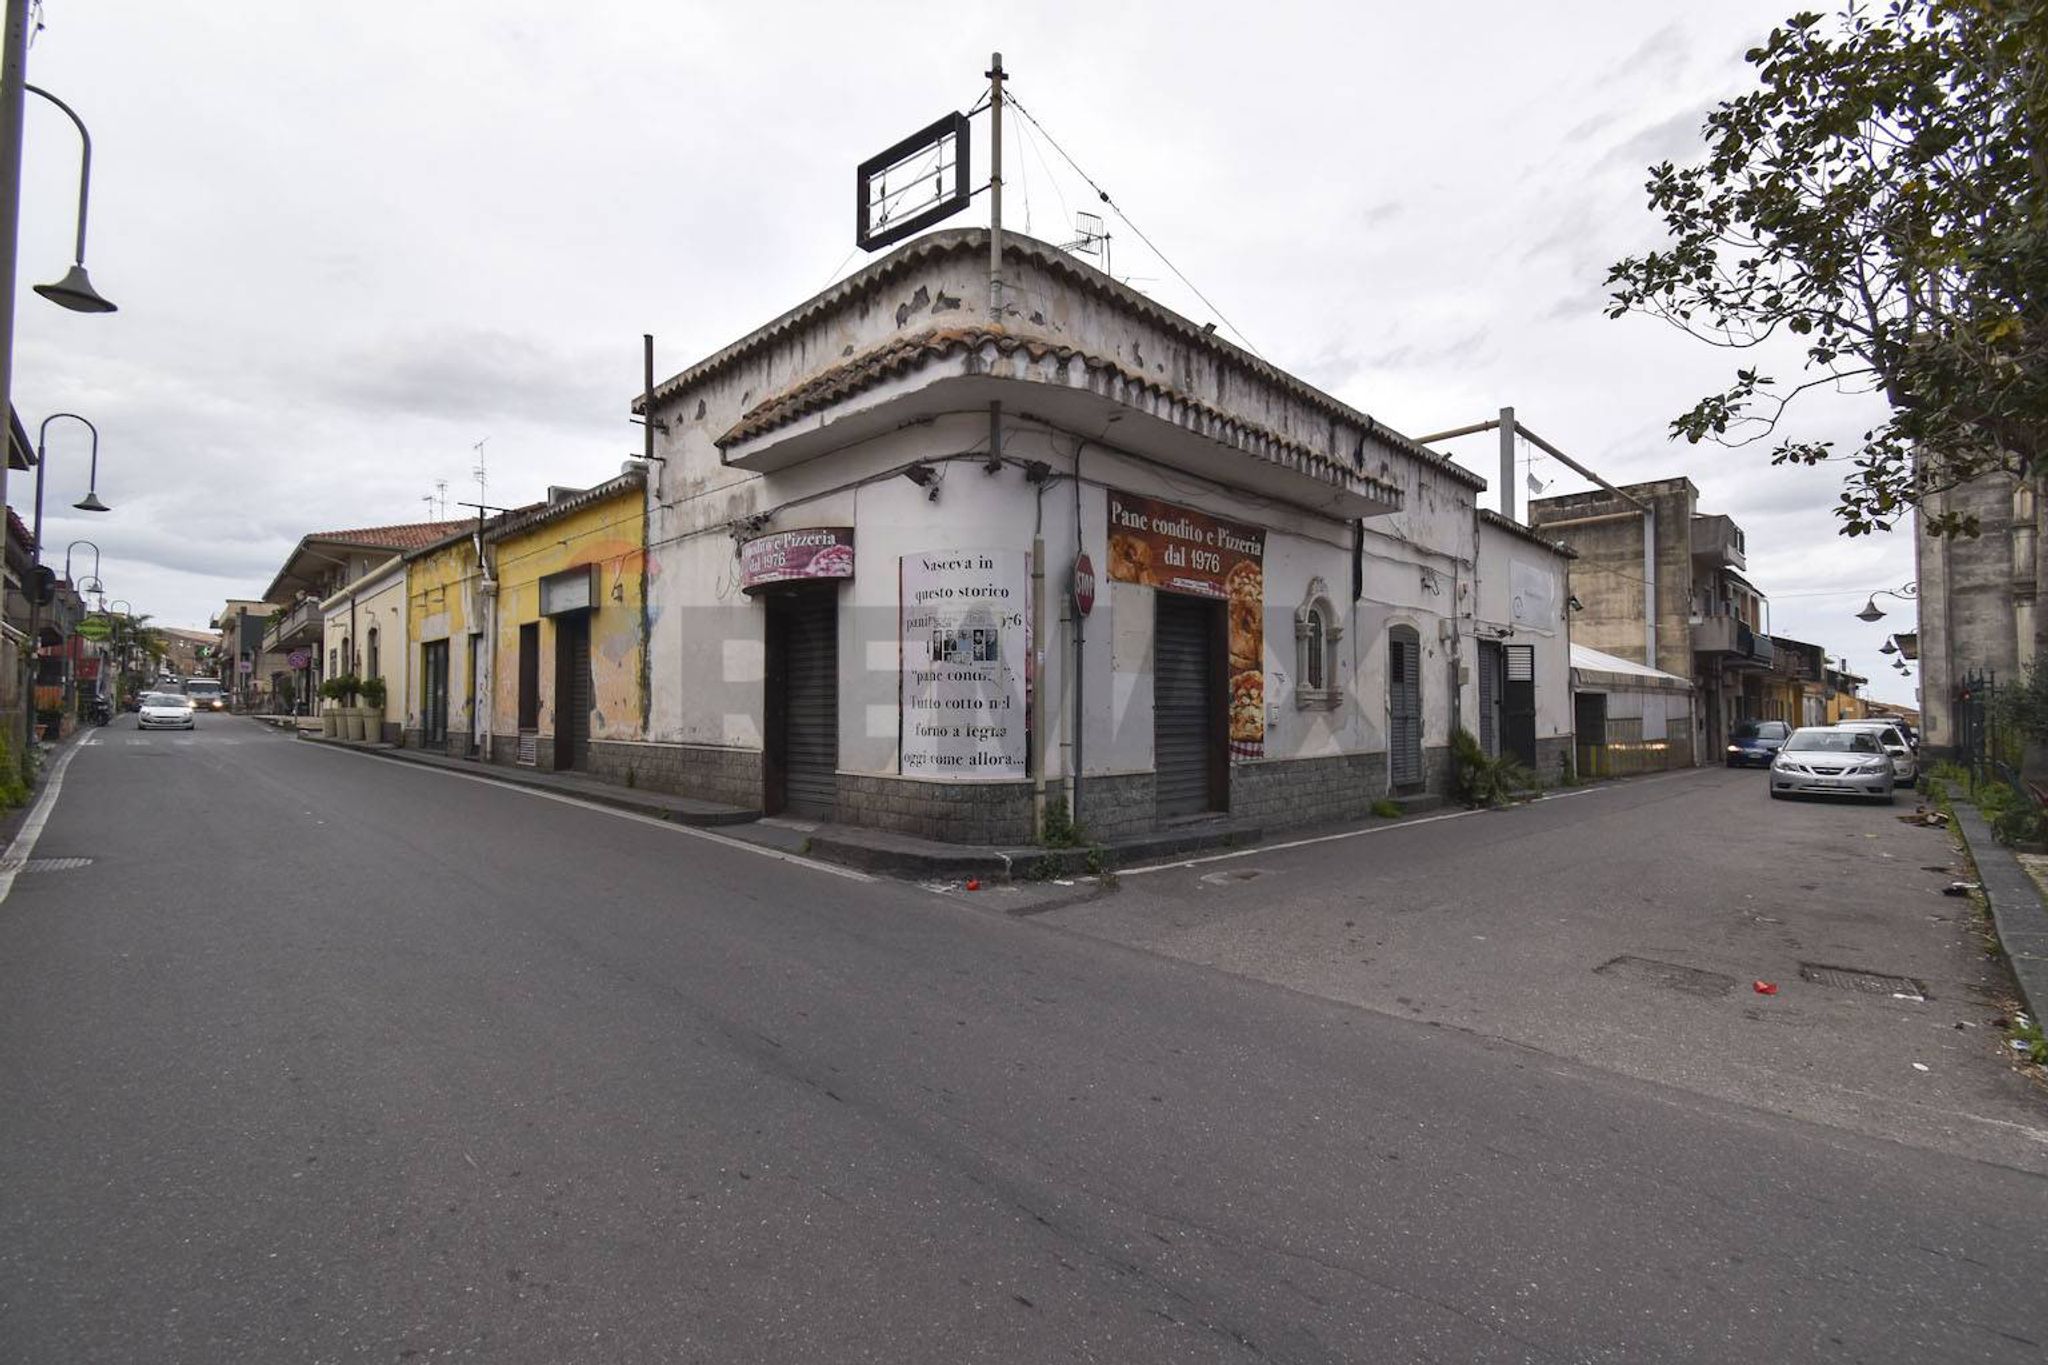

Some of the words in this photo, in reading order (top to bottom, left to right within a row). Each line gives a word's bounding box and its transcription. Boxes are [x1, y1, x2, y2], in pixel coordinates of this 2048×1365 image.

[1111, 501, 1149, 531] Pane
[1152, 517, 1203, 543] condito
[1206, 532, 1214, 545] e
[1217, 526, 1262, 556] Pizzeria
[783, 530, 837, 549] Pizzeria
[763, 551, 787, 569] 1976
[922, 558, 972, 571] Nasceva
[979, 554, 994, 569] in
[1164, 544, 1186, 568] dal
[1191, 549, 1220, 573] 1976
[915, 586, 953, 605] questo
[958, 582, 1010, 599] storico
[1077, 570, 1094, 600] STOP
[911, 695, 941, 710] Tutto
[945, 698, 983, 710] cotto
[915, 722, 948, 737] forno
[952, 727, 960, 738] a
[966, 722, 1007, 742] legna
[904, 750, 927, 768] oggi
[930, 755, 963, 766] come
